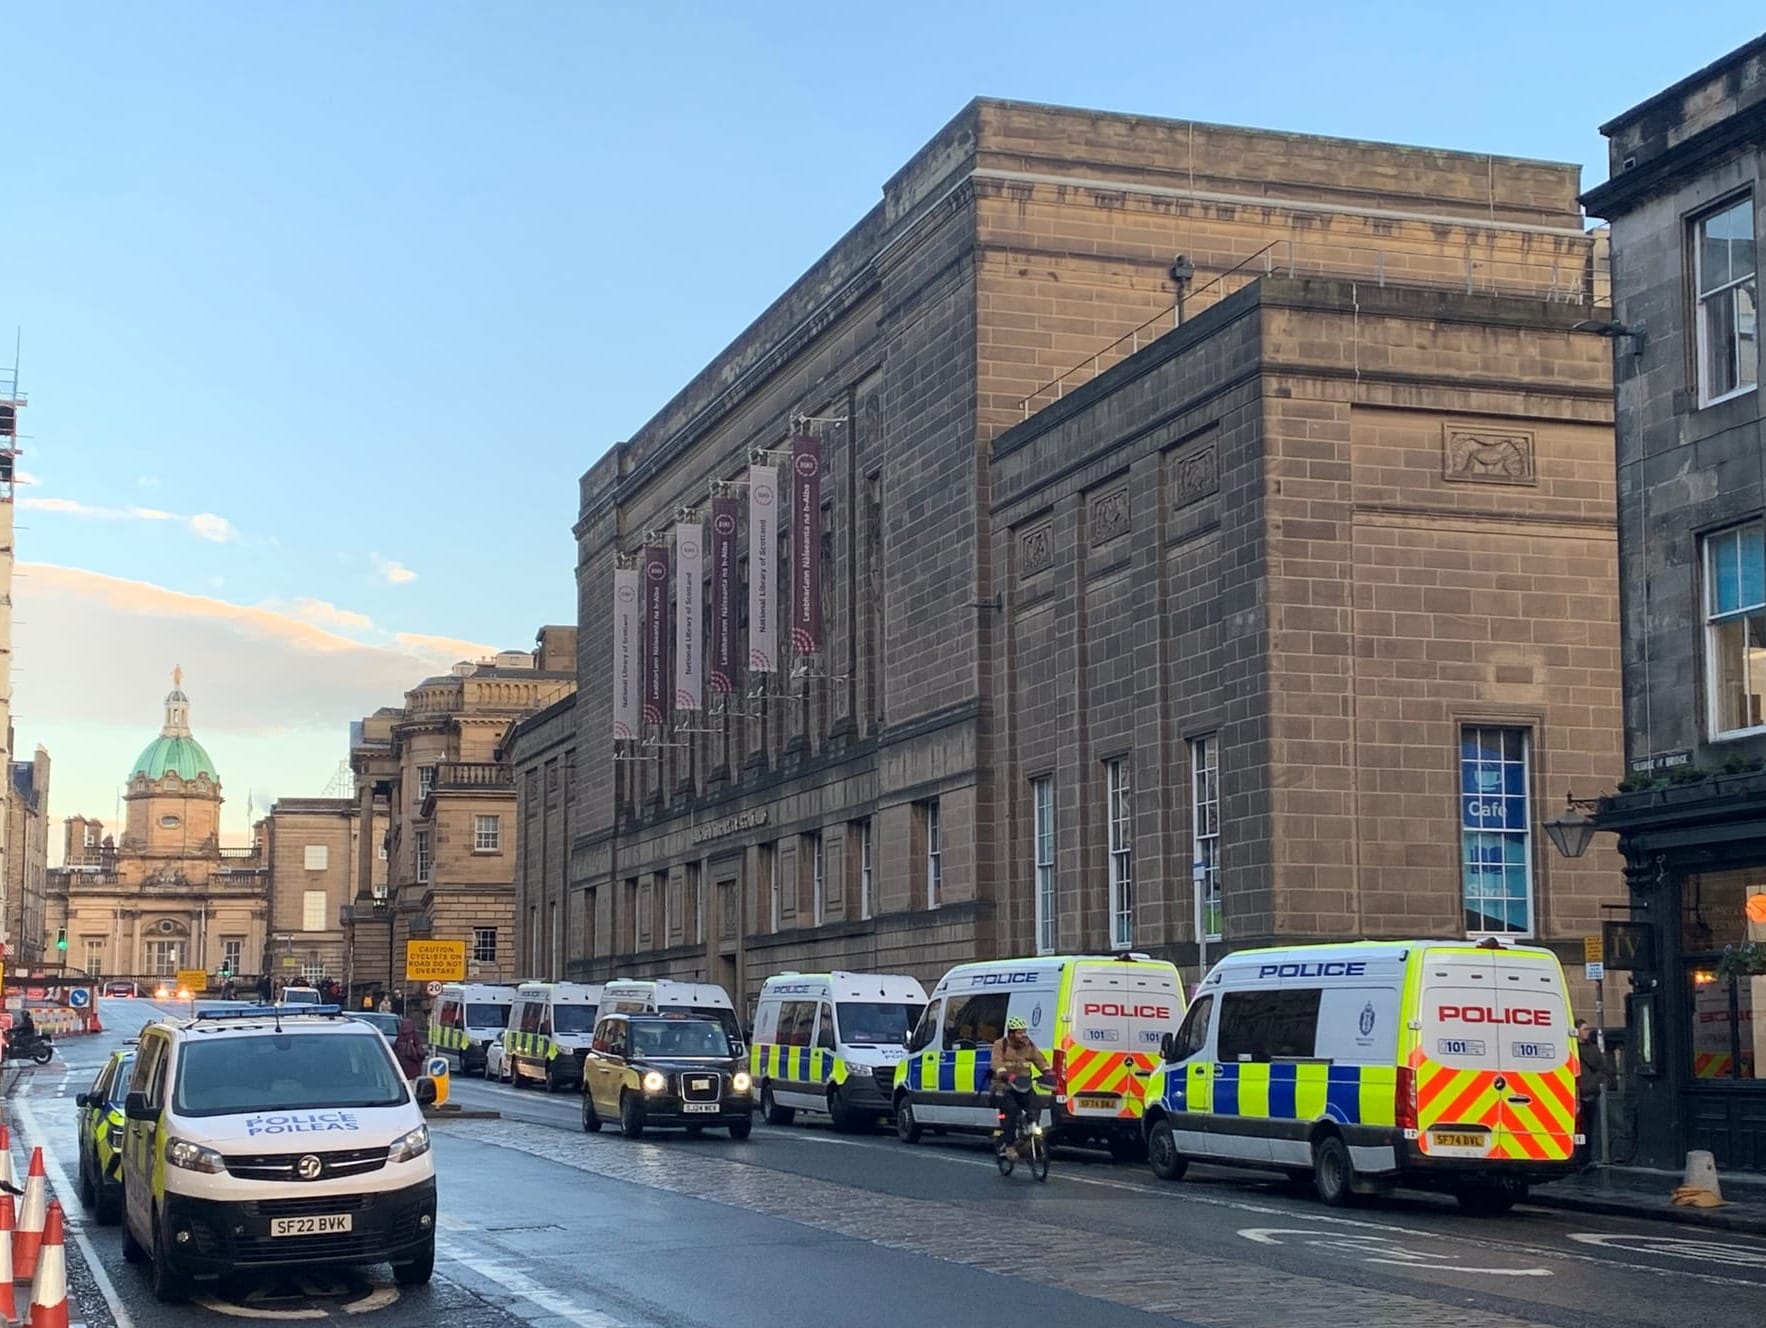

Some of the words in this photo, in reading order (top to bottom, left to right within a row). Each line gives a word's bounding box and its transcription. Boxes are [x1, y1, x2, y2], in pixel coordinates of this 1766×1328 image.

[801, 484, 811, 512] h-Alba
[803, 513, 810, 524] na
[758, 519, 767, 555] Scotland
[720, 541, 729, 566] h-Alba
[759, 556, 767, 566] of
[684, 572, 692, 605] Scotland
[759, 567, 768, 597] Library
[759, 598, 767, 633] National
[685, 616, 693, 643] Library
[622, 654, 630, 678] Library
[1259, 962, 1367, 979] POLICE
[971, 972, 1040, 986] POLICE
[429, 984, 441, 992] 20
[772, 985, 810, 994] POLICE
[1084, 1003, 1170, 1019] POLICE
[1438, 1006, 1552, 1026] POLICE
[1090, 1030, 1104, 1040] 101
[1146, 1033, 1160, 1043] 101
[1446, 1041, 1466, 1053] 101
[1520, 1045, 1538, 1056] 101
[247, 1114, 358, 1128] POLICE
[248, 1123, 360, 1136] POILEAS
[1436, 1134, 1462, 1146] SF74
[278, 1218, 315, 1234] SF22
[318, 1217, 346, 1231] BVK
